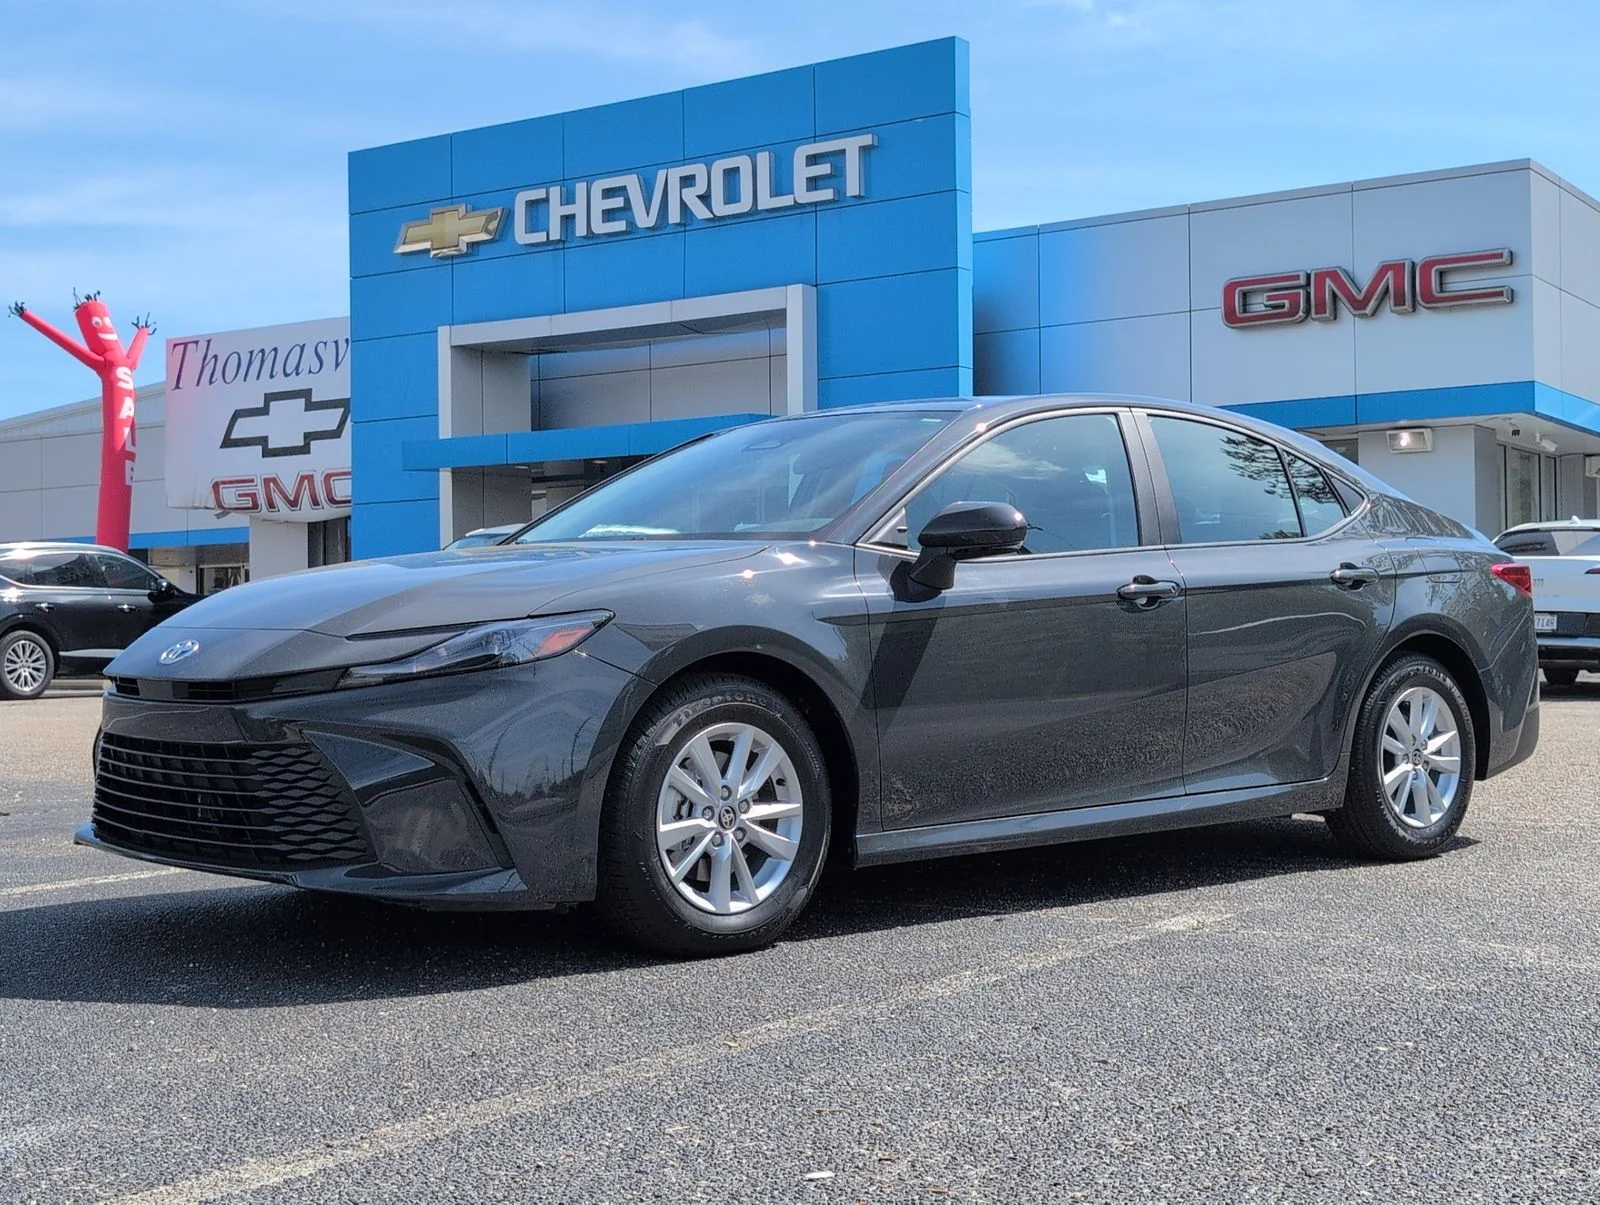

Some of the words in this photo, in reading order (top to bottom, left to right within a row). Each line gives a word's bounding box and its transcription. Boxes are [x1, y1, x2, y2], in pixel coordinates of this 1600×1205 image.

[514, 134, 878, 245] CHEVROLET
[1221, 248, 1513, 328] GMC
[171, 337, 350, 391] Thomasv
[210, 468, 351, 513] GMC
